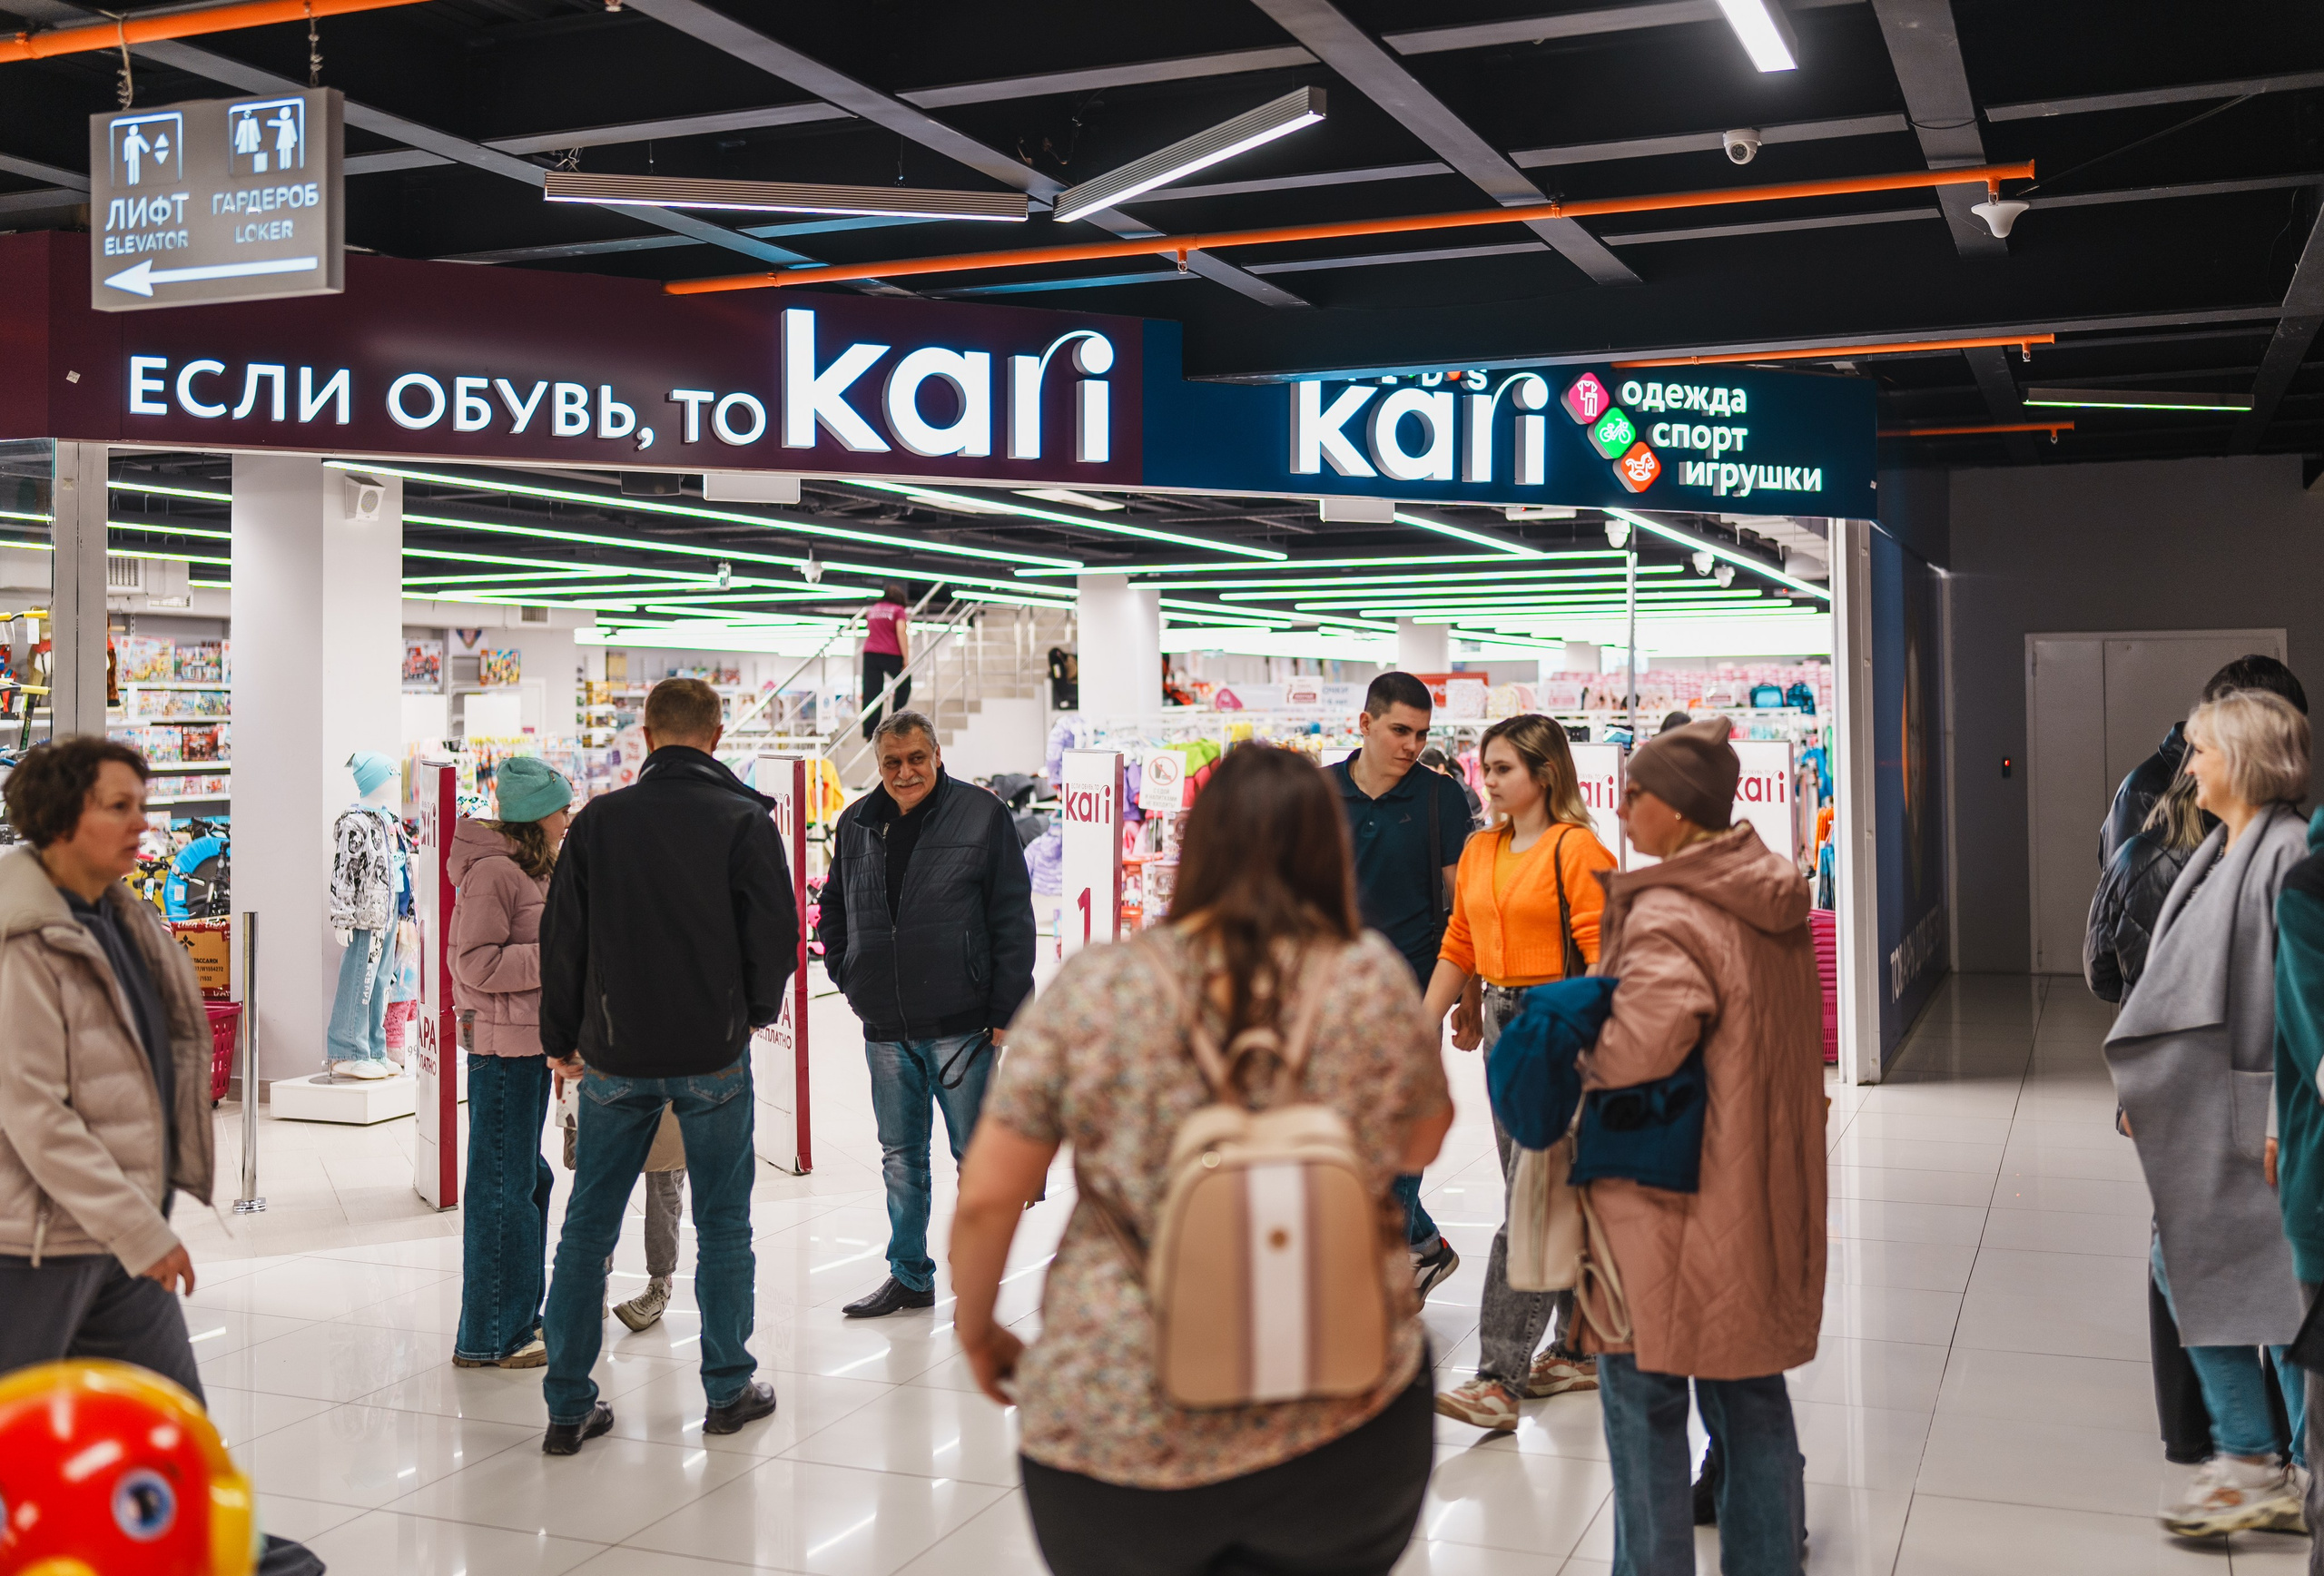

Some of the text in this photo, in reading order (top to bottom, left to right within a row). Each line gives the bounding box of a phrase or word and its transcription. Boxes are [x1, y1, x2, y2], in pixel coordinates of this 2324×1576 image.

[105, 192, 190, 231] ЛИФТ
[212, 182, 320, 215] ГАРДЕРОБ
[104, 229, 189, 256] ELEVATOR
[234, 219, 294, 243] LOKER
[130, 307, 1115, 464] ЕСЛИ ОБУВЬ, ТО kari
[1620, 380, 1748, 417] одежда
[1291, 371, 1549, 486] kari
[1651, 421, 1749, 459] спорт
[1685, 460, 1823, 497] игрушки
[1066, 783, 1110, 824] kari
[1579, 774, 1614, 809] ari
